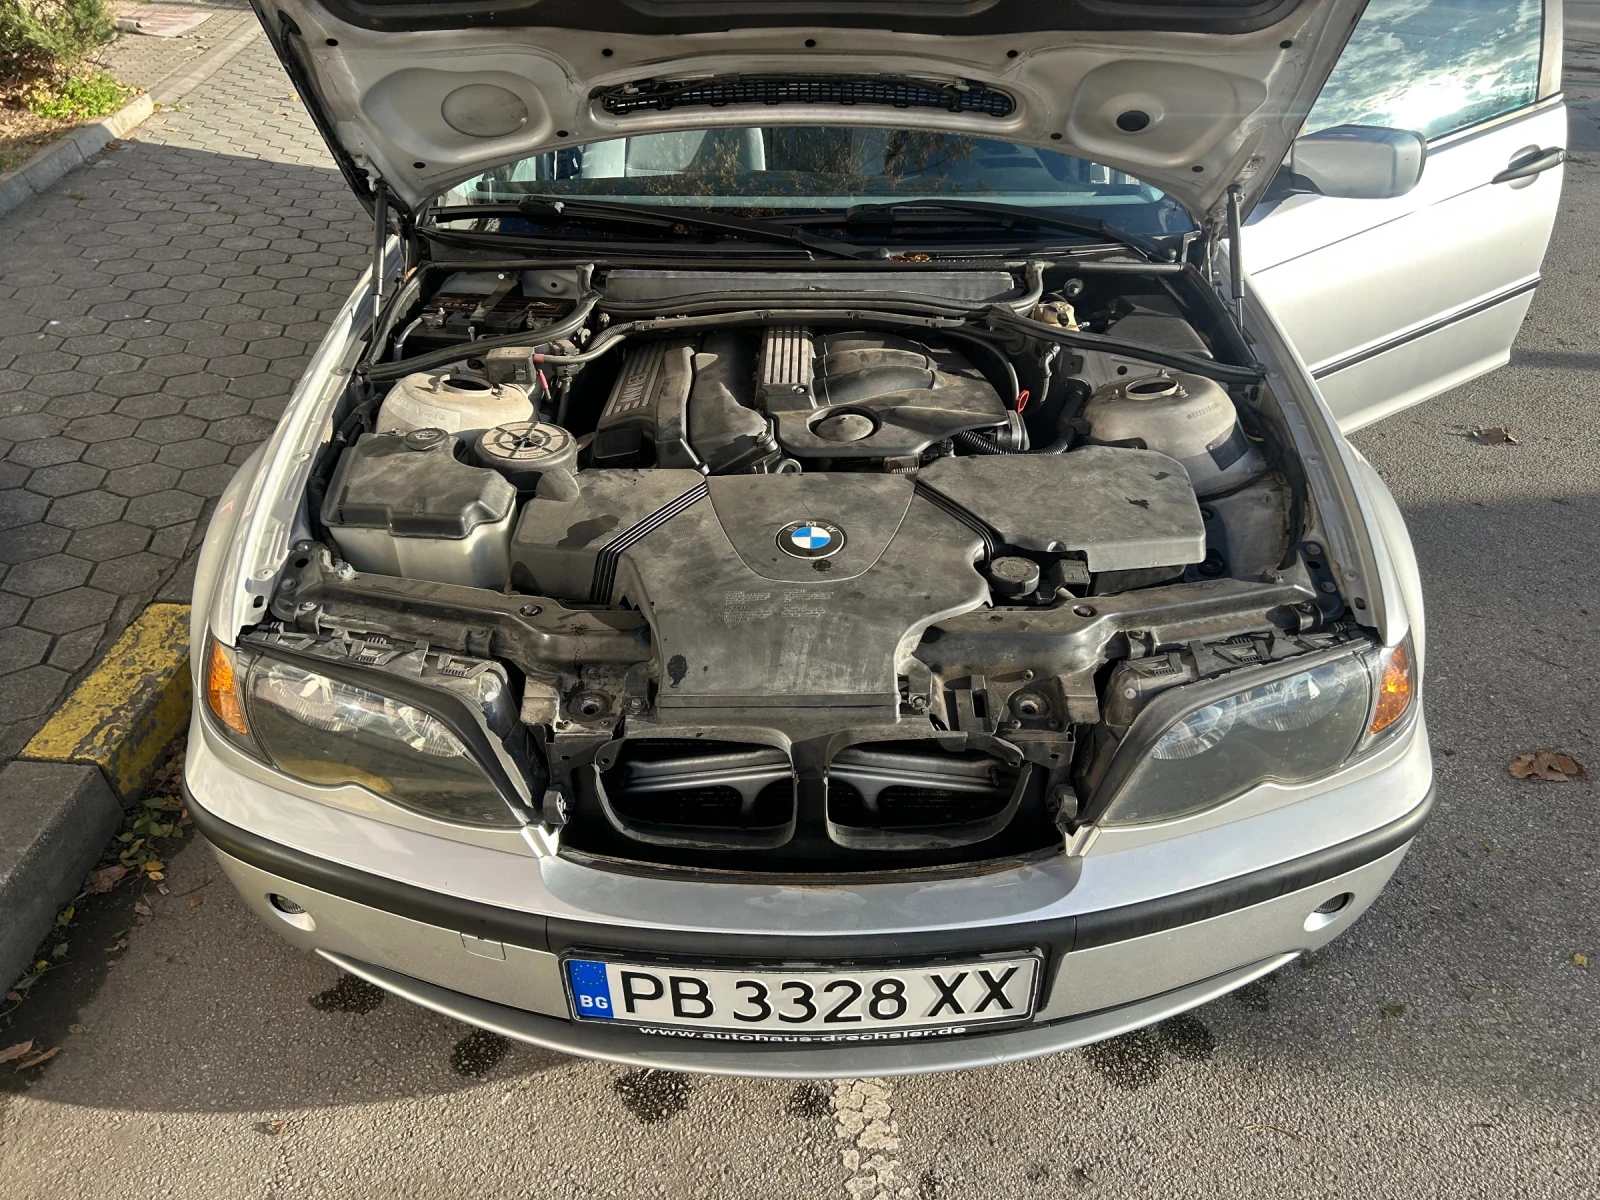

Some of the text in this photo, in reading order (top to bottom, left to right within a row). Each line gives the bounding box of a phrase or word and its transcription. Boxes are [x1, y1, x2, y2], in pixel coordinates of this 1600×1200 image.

[620, 370, 650, 403] BMW
[786, 521, 838, 533] BMW
[580, 994, 609, 1010] BG
[620, 966, 1020, 1024] PB 3328 XX
[638, 1026, 967, 1043] www.autohaus-drechsler.de
